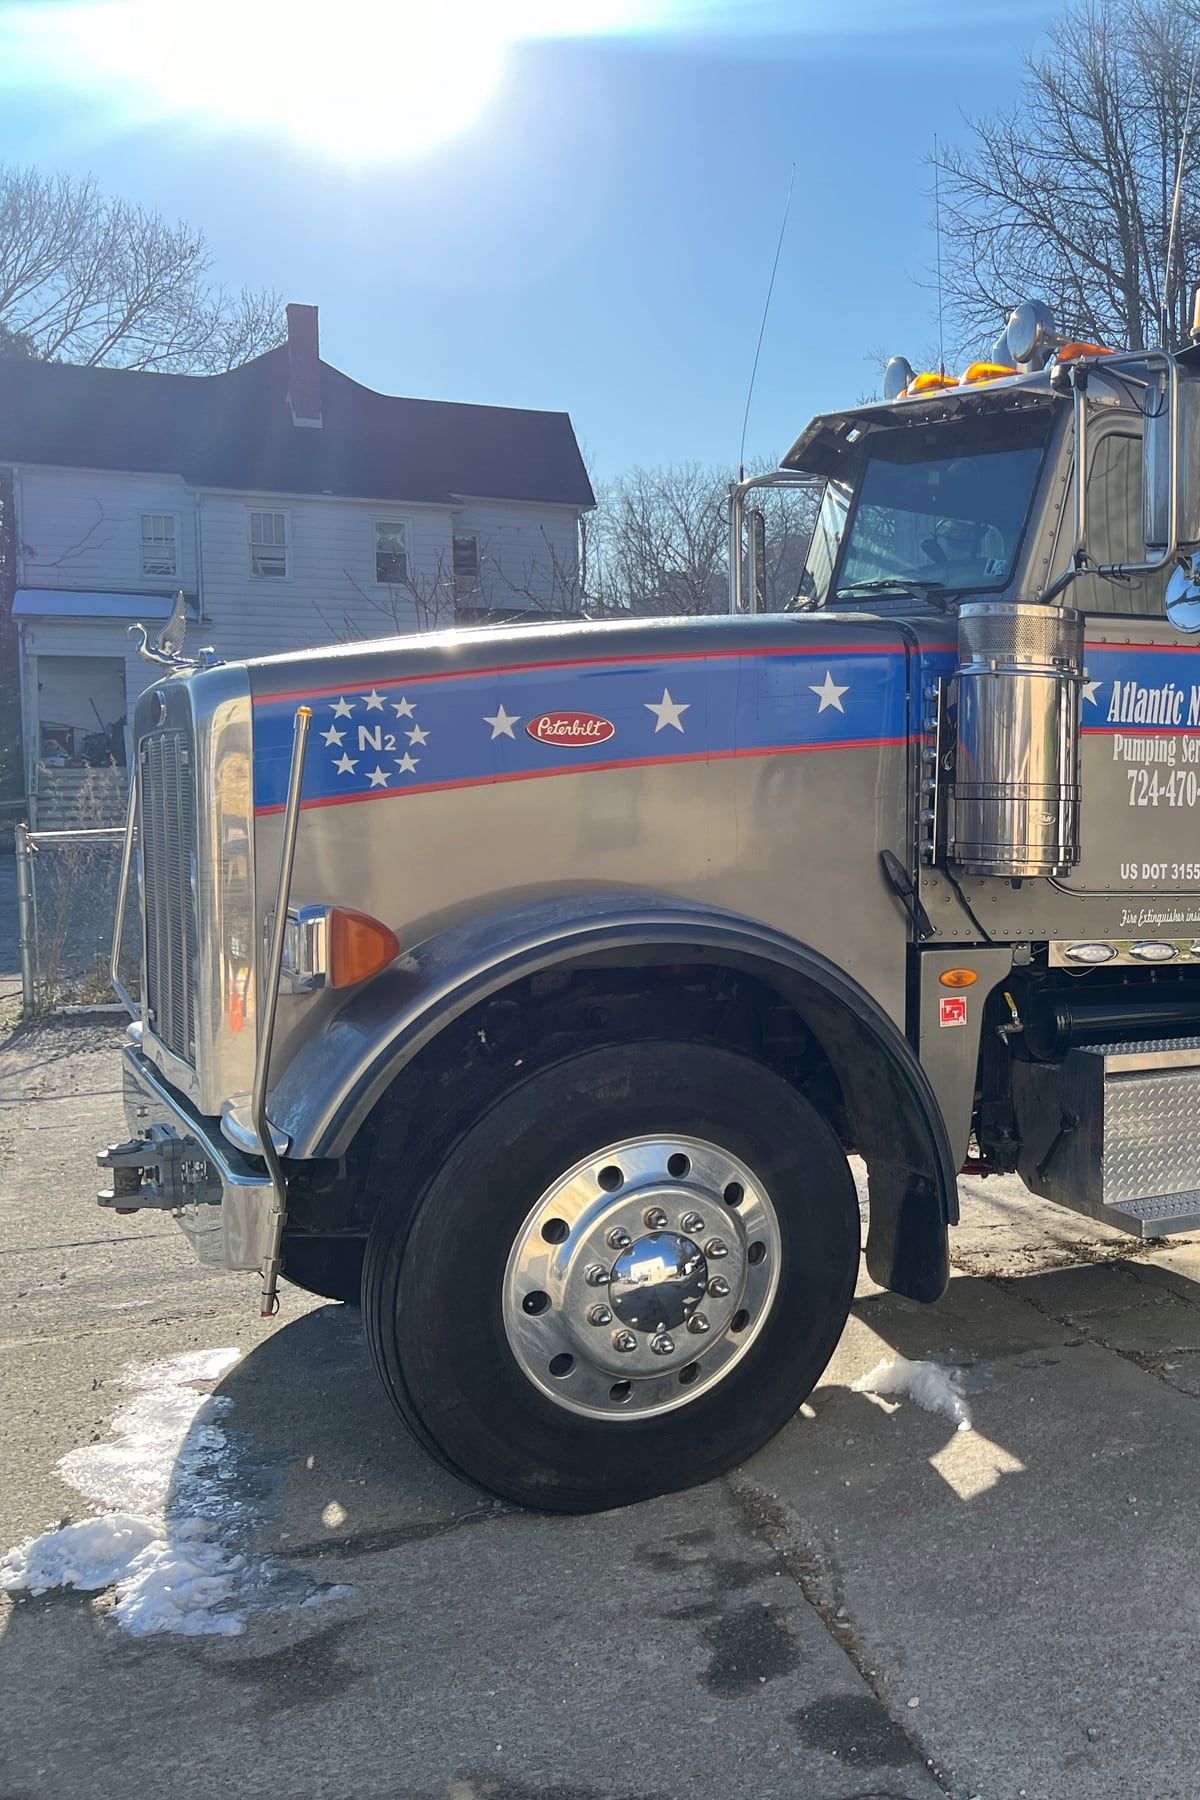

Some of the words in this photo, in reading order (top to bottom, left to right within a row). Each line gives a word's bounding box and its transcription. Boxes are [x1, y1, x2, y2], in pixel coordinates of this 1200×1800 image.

[1106, 680, 1184, 725] Atlantic
[536, 717, 606, 737] Peterbilt
[1113, 734, 1176, 767] Pumping
[1120, 863, 1140, 880] US
[1142, 863, 1168, 880] DOT
[1120, 909, 1137, 927] Fire
[1137, 908, 1185, 927] Extinguisher
